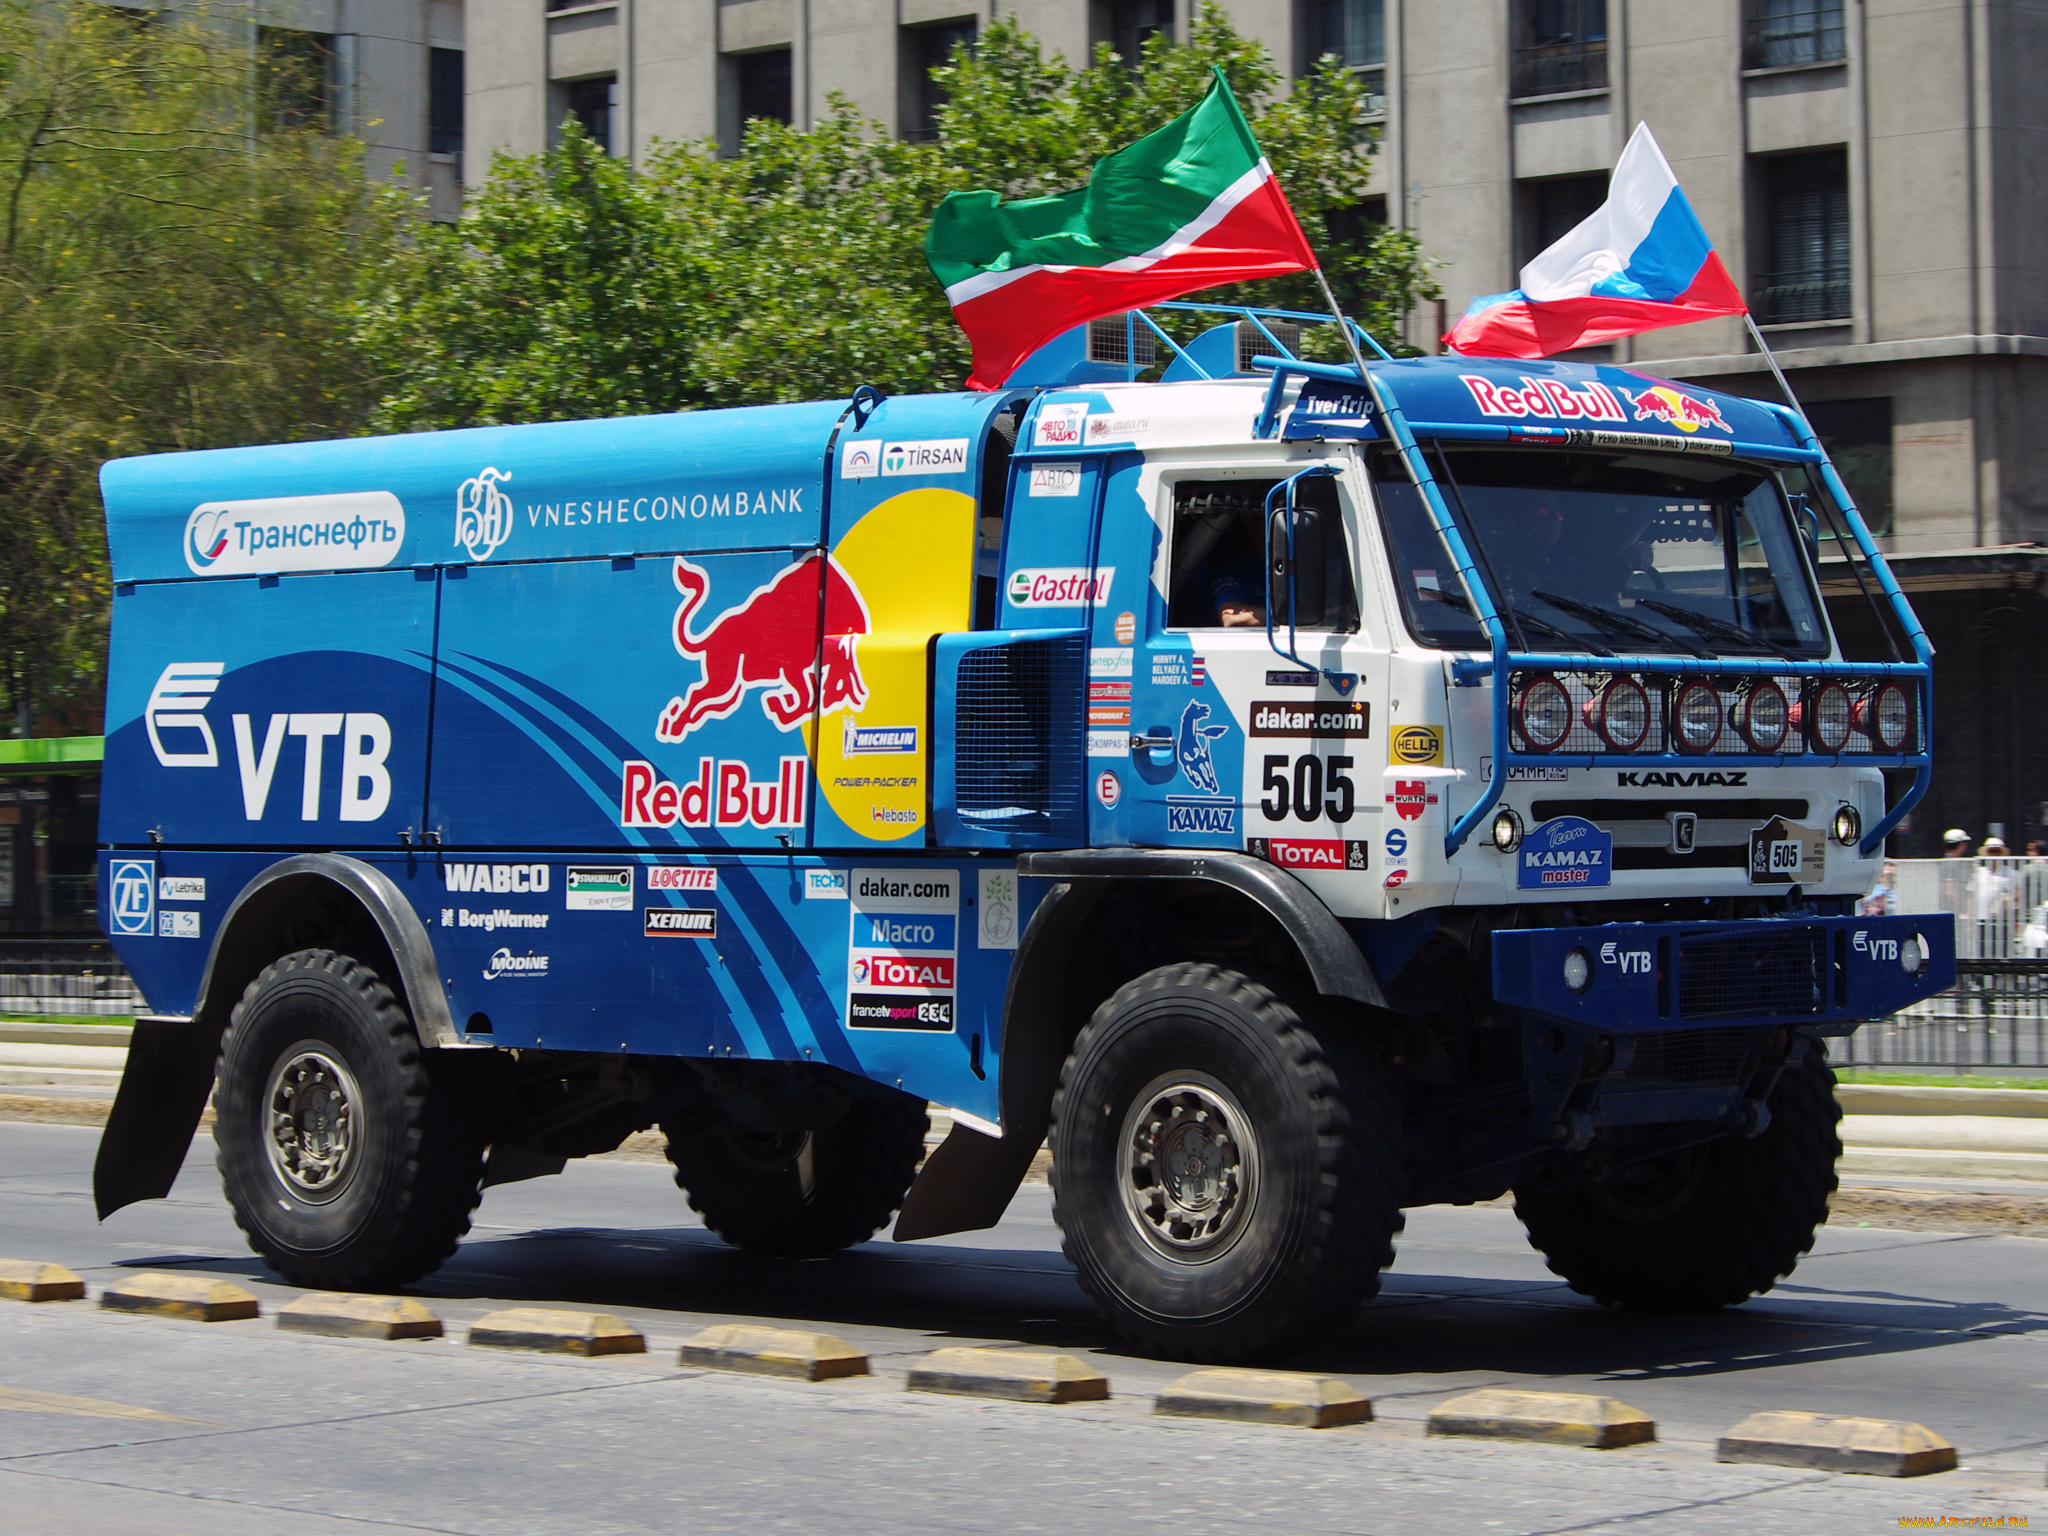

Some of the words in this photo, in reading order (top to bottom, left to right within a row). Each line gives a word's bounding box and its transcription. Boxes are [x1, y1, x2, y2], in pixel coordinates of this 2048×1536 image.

[1459, 375, 1557, 418] Red
[1543, 379, 1628, 422] Bull
[1040, 421, 1066, 432] АВТО
[1113, 419, 1149, 431] auto.ru
[1046, 430, 1078, 442] РАДИО
[1689, 440, 1730, 453] dakar.com
[527, 488, 803, 527] VNESHECONOMBANK
[234, 515, 396, 556] Транснефть
[1031, 574, 1106, 601] Castrol
[1152, 655, 1177, 664] MIRNYY
[1152, 665, 1180, 675] BELYAEV
[1254, 707, 1363, 730] dakar.com
[856, 728, 914, 746] MICHELIN
[1397, 739, 1439, 751] HELLA
[232, 713, 391, 822] VTB
[833, 777, 917, 788] POWER-PACKER
[1102, 779, 1113, 798] E
[1260, 754, 1355, 824] 505
[1617, 772, 1748, 787] KAMAZ
[622, 757, 713, 827] Red
[715, 756, 808, 828] Bull
[872, 806, 917, 824] Webasto
[1168, 807, 1234, 833] KAMAZ
[1546, 822, 1588, 848] Team
[1272, 843, 1342, 863] TOTAL
[1525, 850, 1603, 868] KAMAZ
[1773, 844, 1798, 868] 505
[444, 864, 549, 893] WABCO
[650, 869, 714, 888] LOCTITE
[1542, 868, 1590, 884] master
[859, 877, 949, 898] dakar.com
[458, 909, 549, 931] BorgWarner
[872, 919, 935, 943] Macro
[1868, 939, 1898, 961] VTB
[491, 956, 549, 970] MODINE
[873, 959, 950, 984] TOTAL
[1618, 951, 1652, 974] VTB
